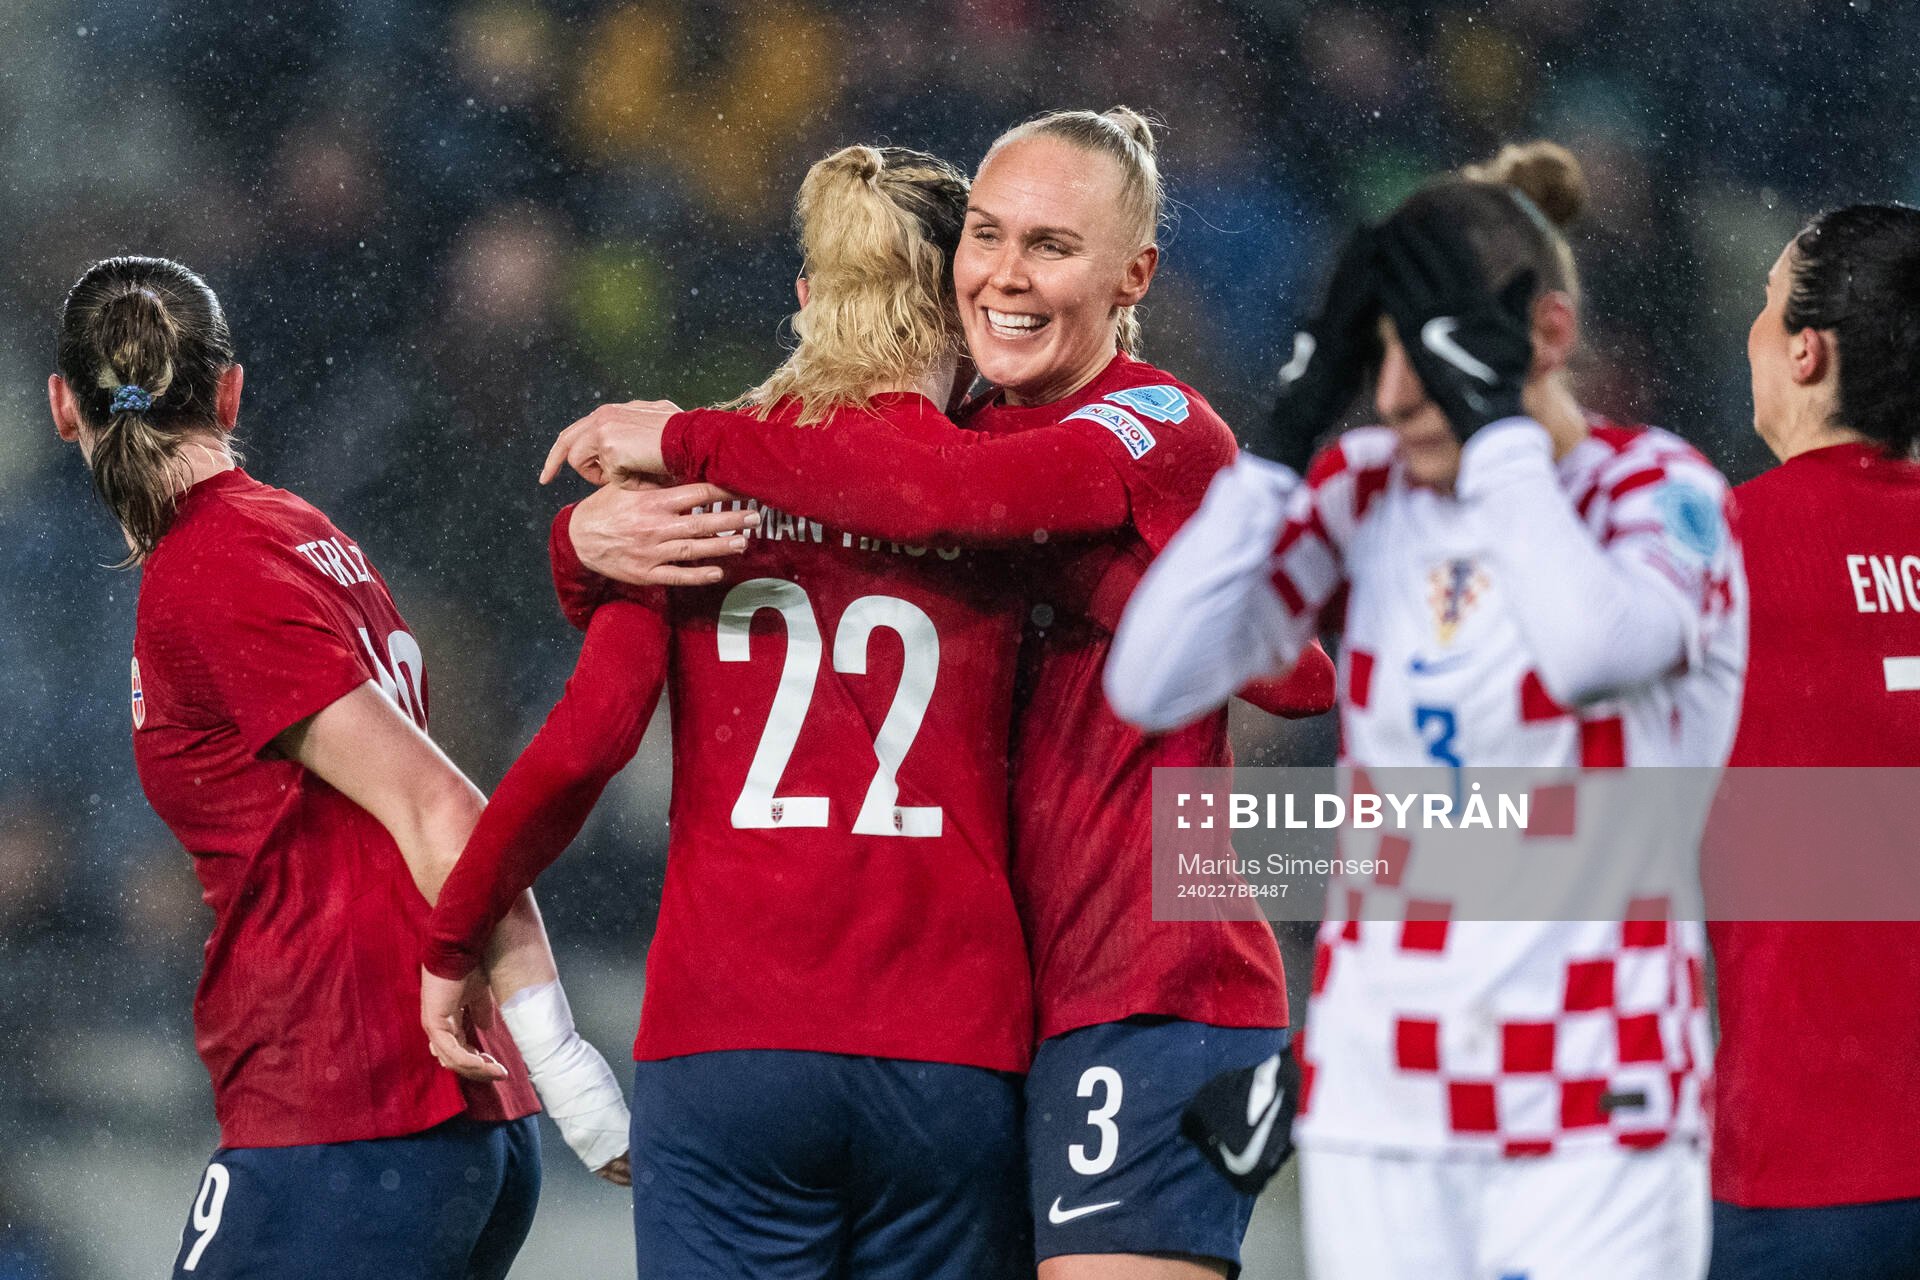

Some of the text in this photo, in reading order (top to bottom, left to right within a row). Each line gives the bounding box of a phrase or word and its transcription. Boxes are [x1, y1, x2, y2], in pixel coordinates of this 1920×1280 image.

[1087, 407, 1149, 452] NDATION
[717, 577, 943, 838] 22
[1412, 704, 1463, 821] 3
[1068, 1066, 1123, 1175] 3
[183, 1163, 230, 1271] 9
